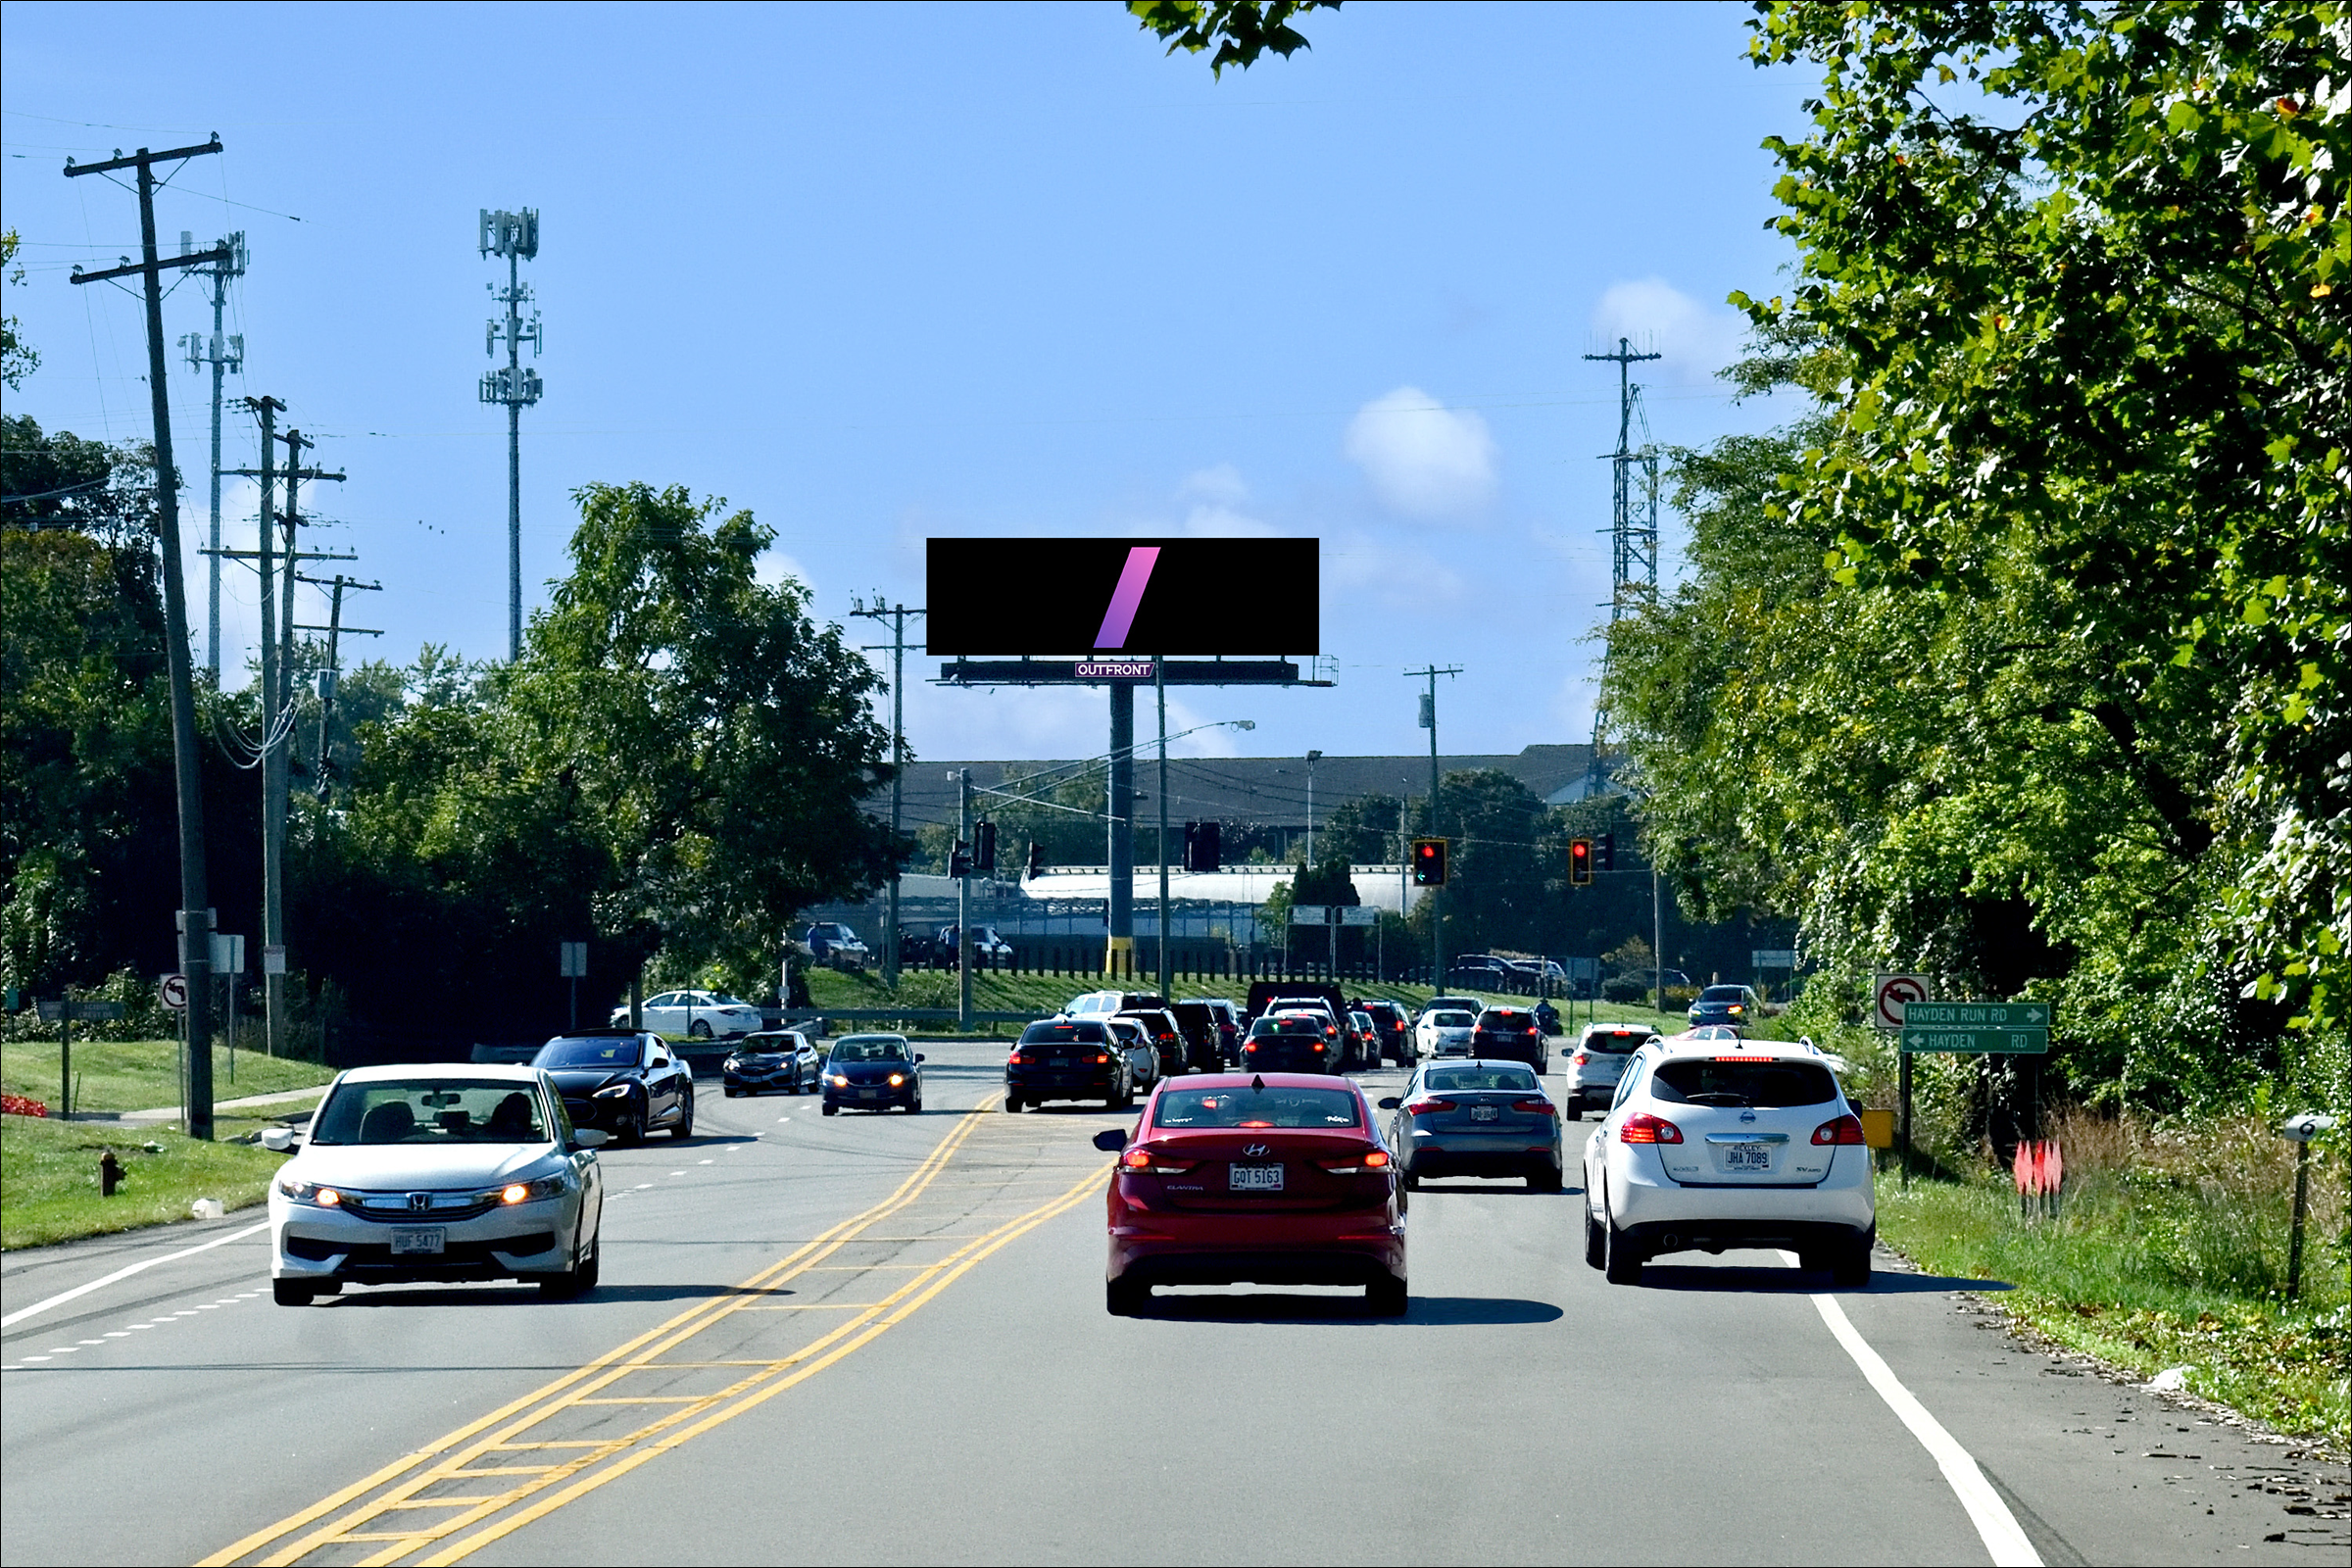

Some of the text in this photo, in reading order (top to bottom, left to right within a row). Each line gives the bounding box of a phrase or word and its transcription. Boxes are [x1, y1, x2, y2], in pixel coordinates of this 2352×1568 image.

[1078, 663, 1151, 675] OUTFRONT
[1908, 1007, 2007, 1022] HAYDEN RUN RD
[1929, 1034, 2028, 1049] HAYDEN RD
[2299, 1118, 2316, 1137] 6
[1728, 1152, 1768, 1164] JHA 7089
[1254, 1170, 1280, 1184] 5163
[416, 1234, 440, 1248] 5477
